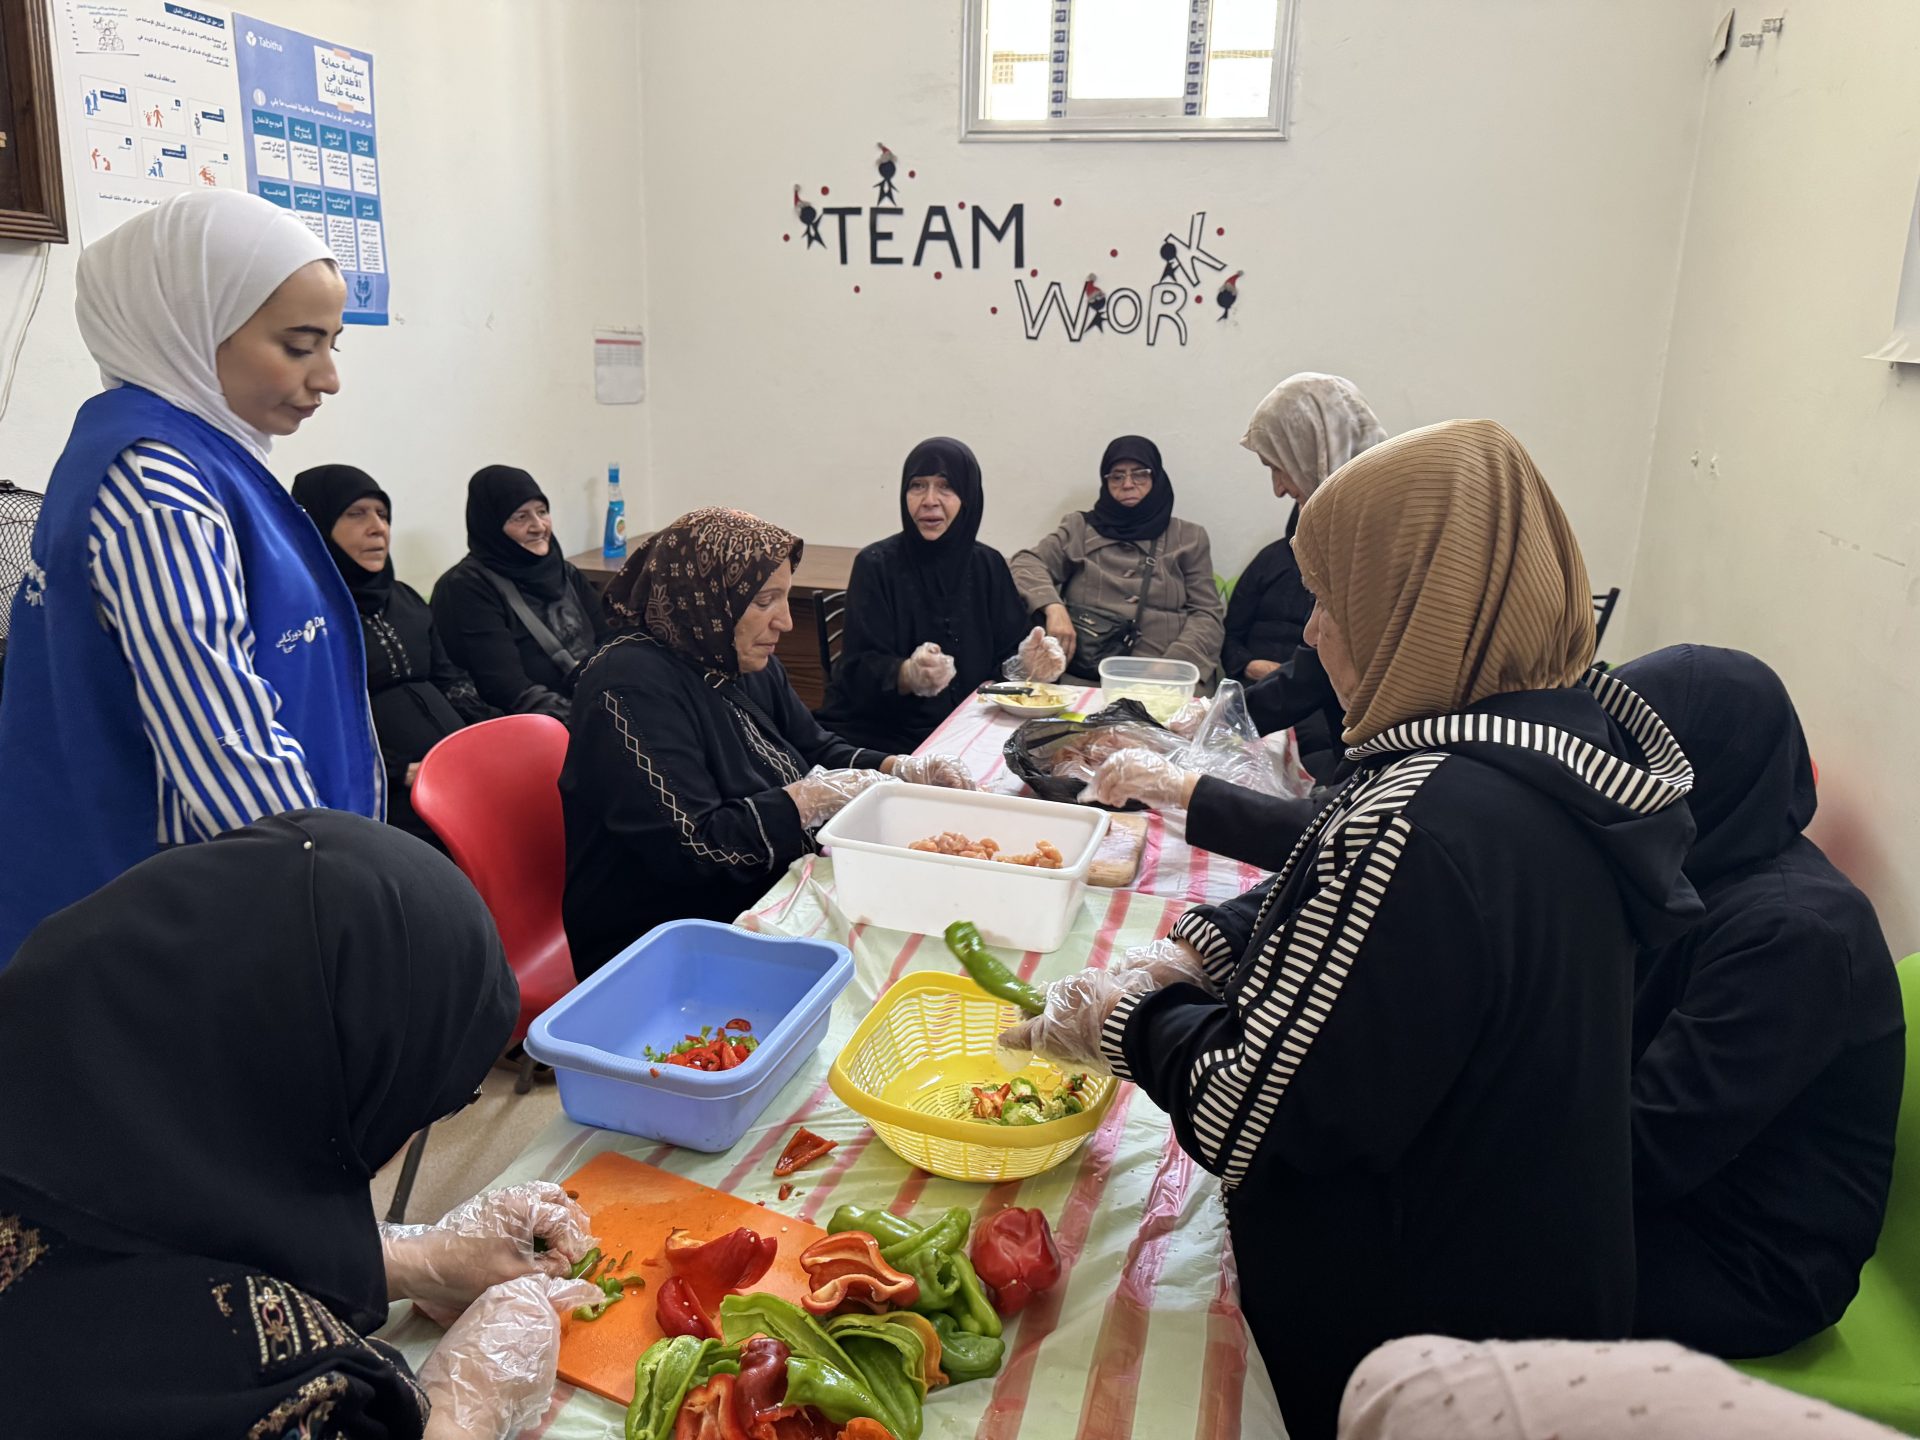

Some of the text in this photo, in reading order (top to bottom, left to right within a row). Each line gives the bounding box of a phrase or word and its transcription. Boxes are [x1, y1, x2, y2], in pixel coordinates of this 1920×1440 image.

[257, 36, 283, 53] Tabitha
[321, 54, 365, 77] سياسة حماية
[337, 74, 362, 89] الأطفال
[344, 88, 366, 104] جمعية
[822, 203, 1025, 270] TEAM
[1014, 211, 1228, 347] WORK
